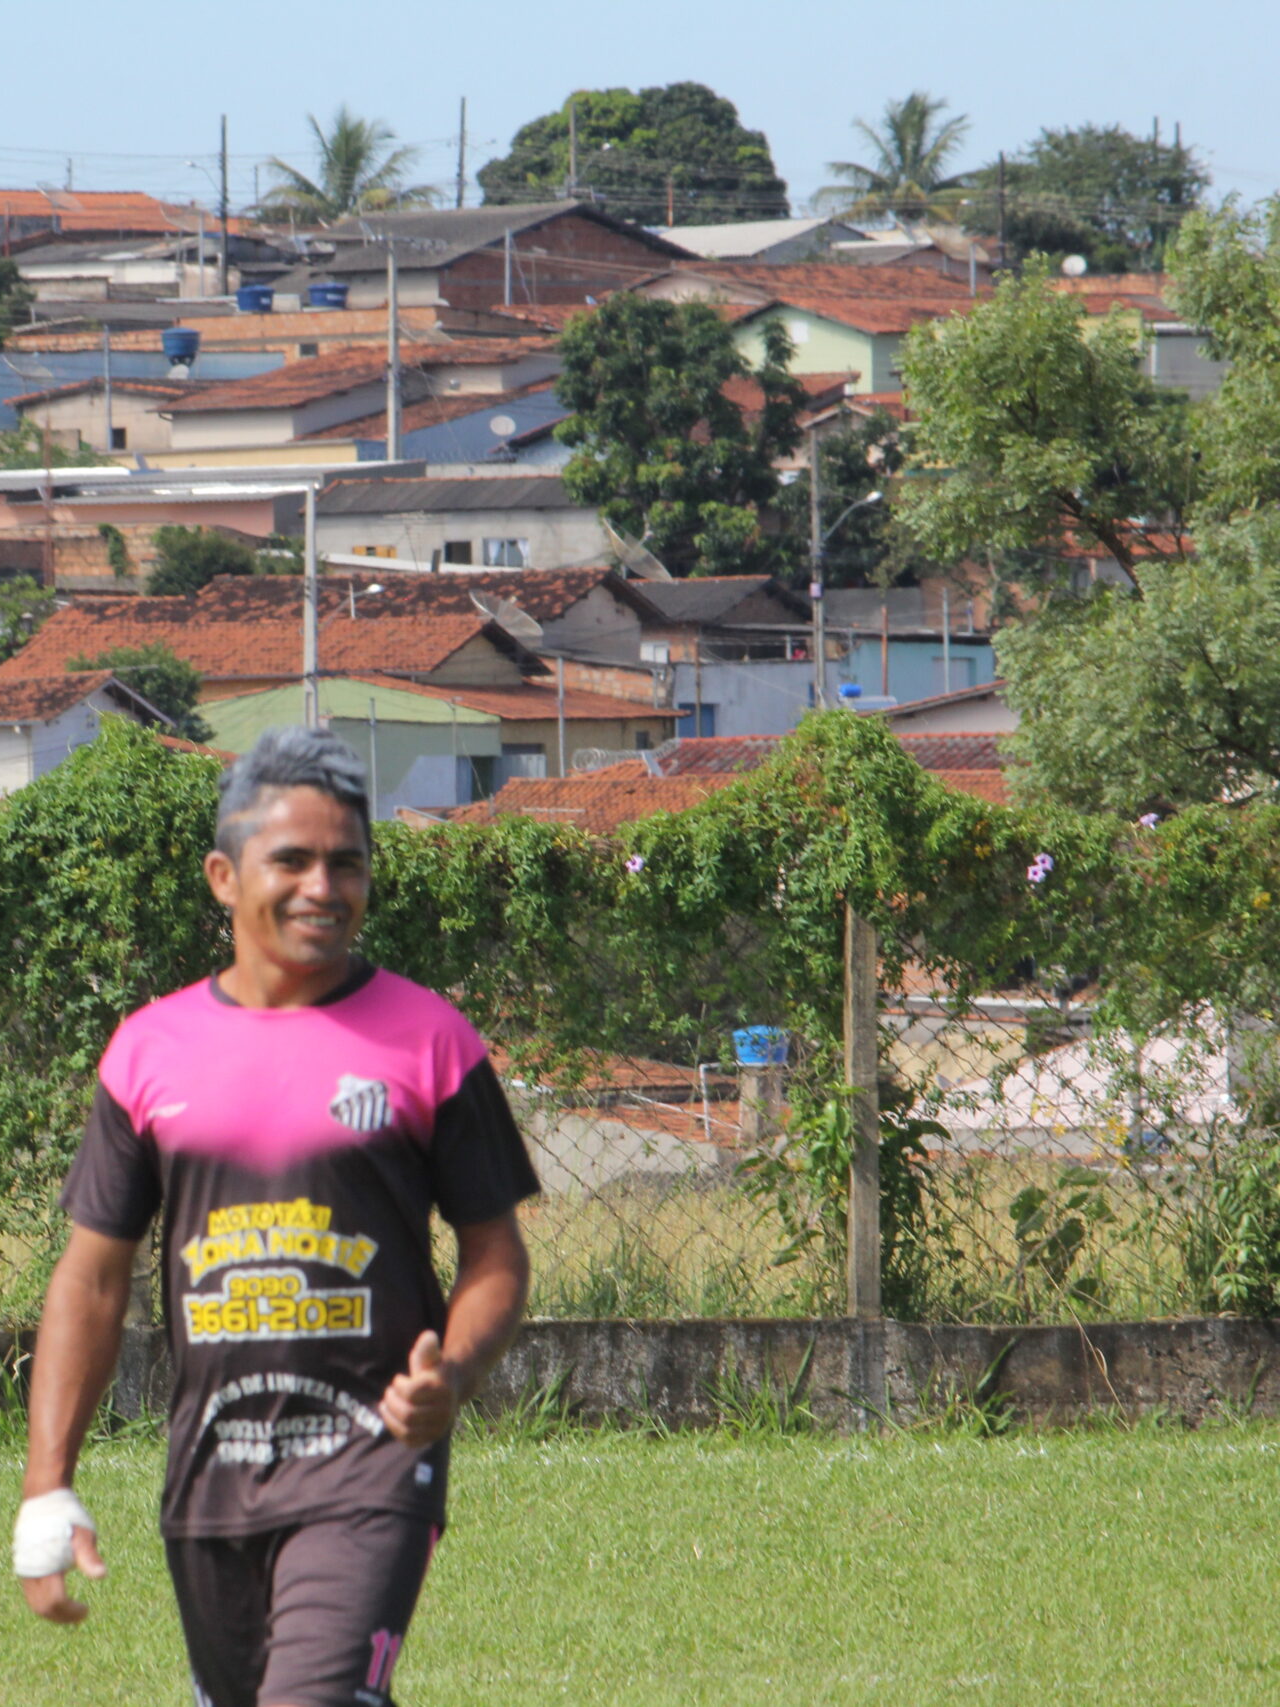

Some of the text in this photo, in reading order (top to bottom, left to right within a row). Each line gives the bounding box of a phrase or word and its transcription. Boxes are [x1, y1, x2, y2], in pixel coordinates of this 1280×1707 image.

[208, 1203, 276, 1237] MOTO
[181, 1227, 377, 1286] ZONA NORTE
[229, 1275, 300, 1298] 9090
[188, 1296, 365, 1335] 3661-2021
